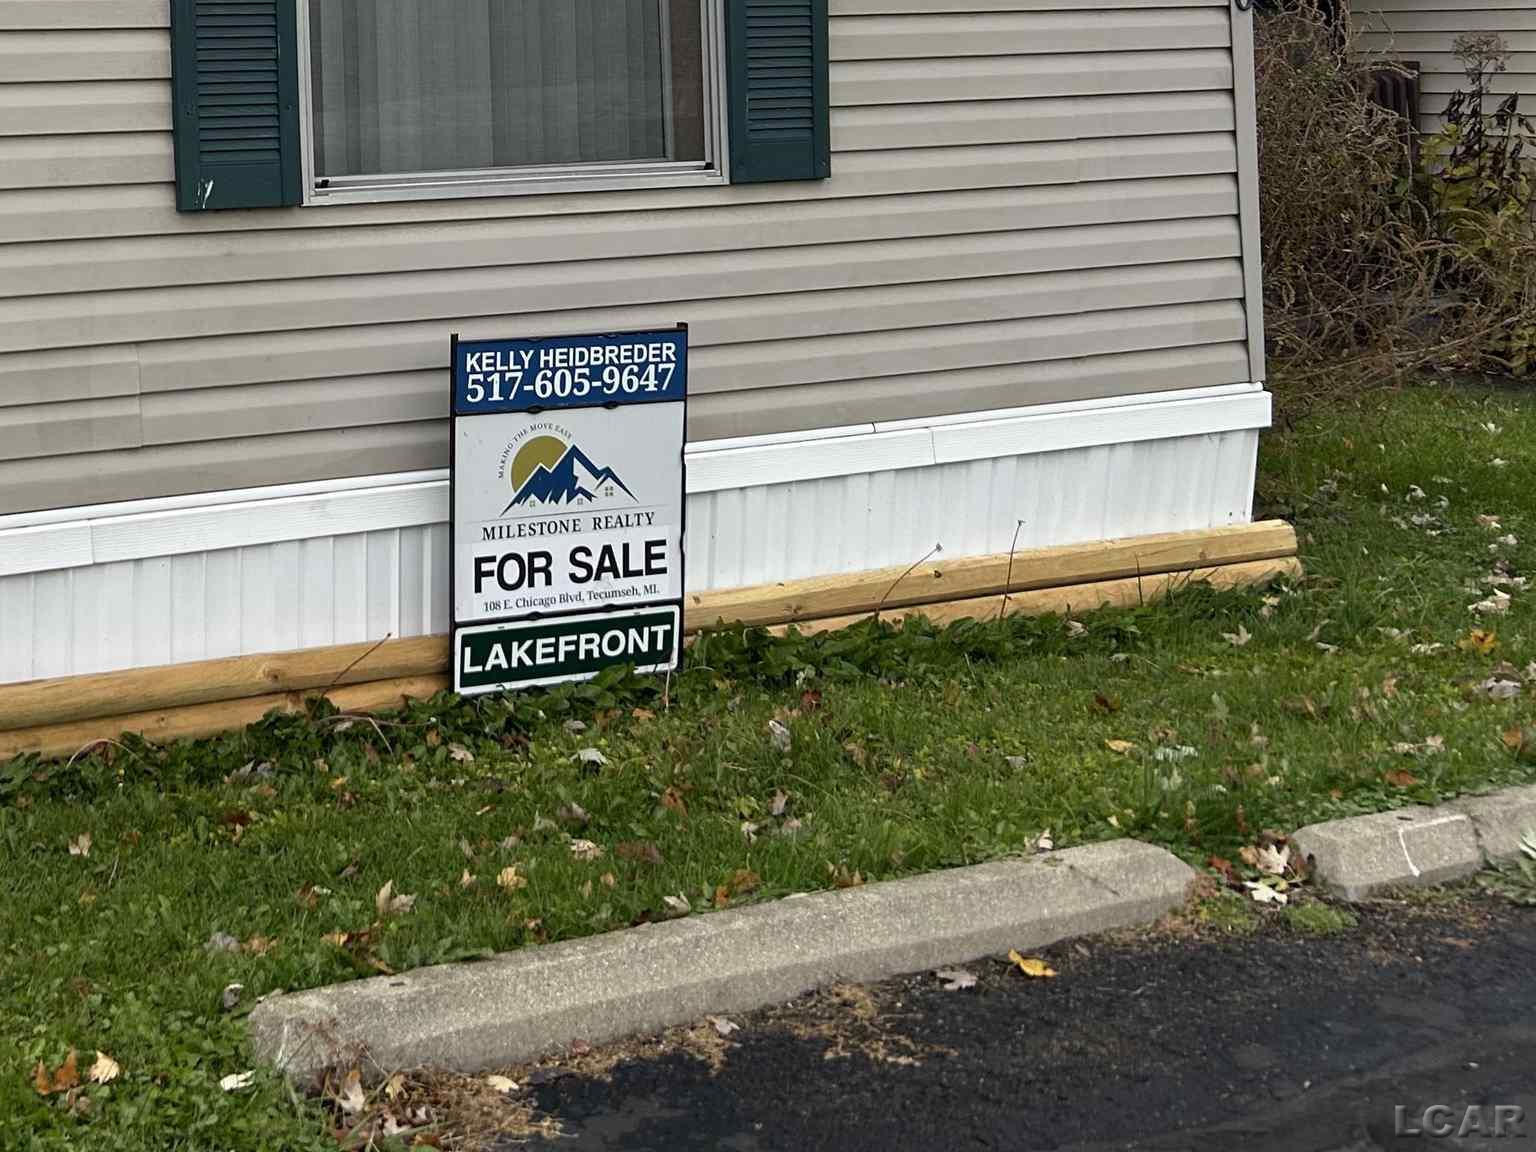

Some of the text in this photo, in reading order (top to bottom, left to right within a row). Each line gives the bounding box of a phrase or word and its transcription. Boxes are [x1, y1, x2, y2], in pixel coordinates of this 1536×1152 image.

[466, 342, 677, 373] KELLY HEIDBREDER
[466, 363, 676, 402] 517-605-9647
[513, 429, 528, 442] THE
[529, 423, 553, 432] MOVE
[482, 511, 655, 541] MILESTONE REALTY
[474, 539, 668, 594] FOR SALE
[484, 600, 501, 612] 108
[503, 599, 513, 609] E.
[515, 596, 556, 608] Chicago
[587, 585, 641, 601] Tecumseh,
[463, 624, 671, 673] LAKEFRONT
